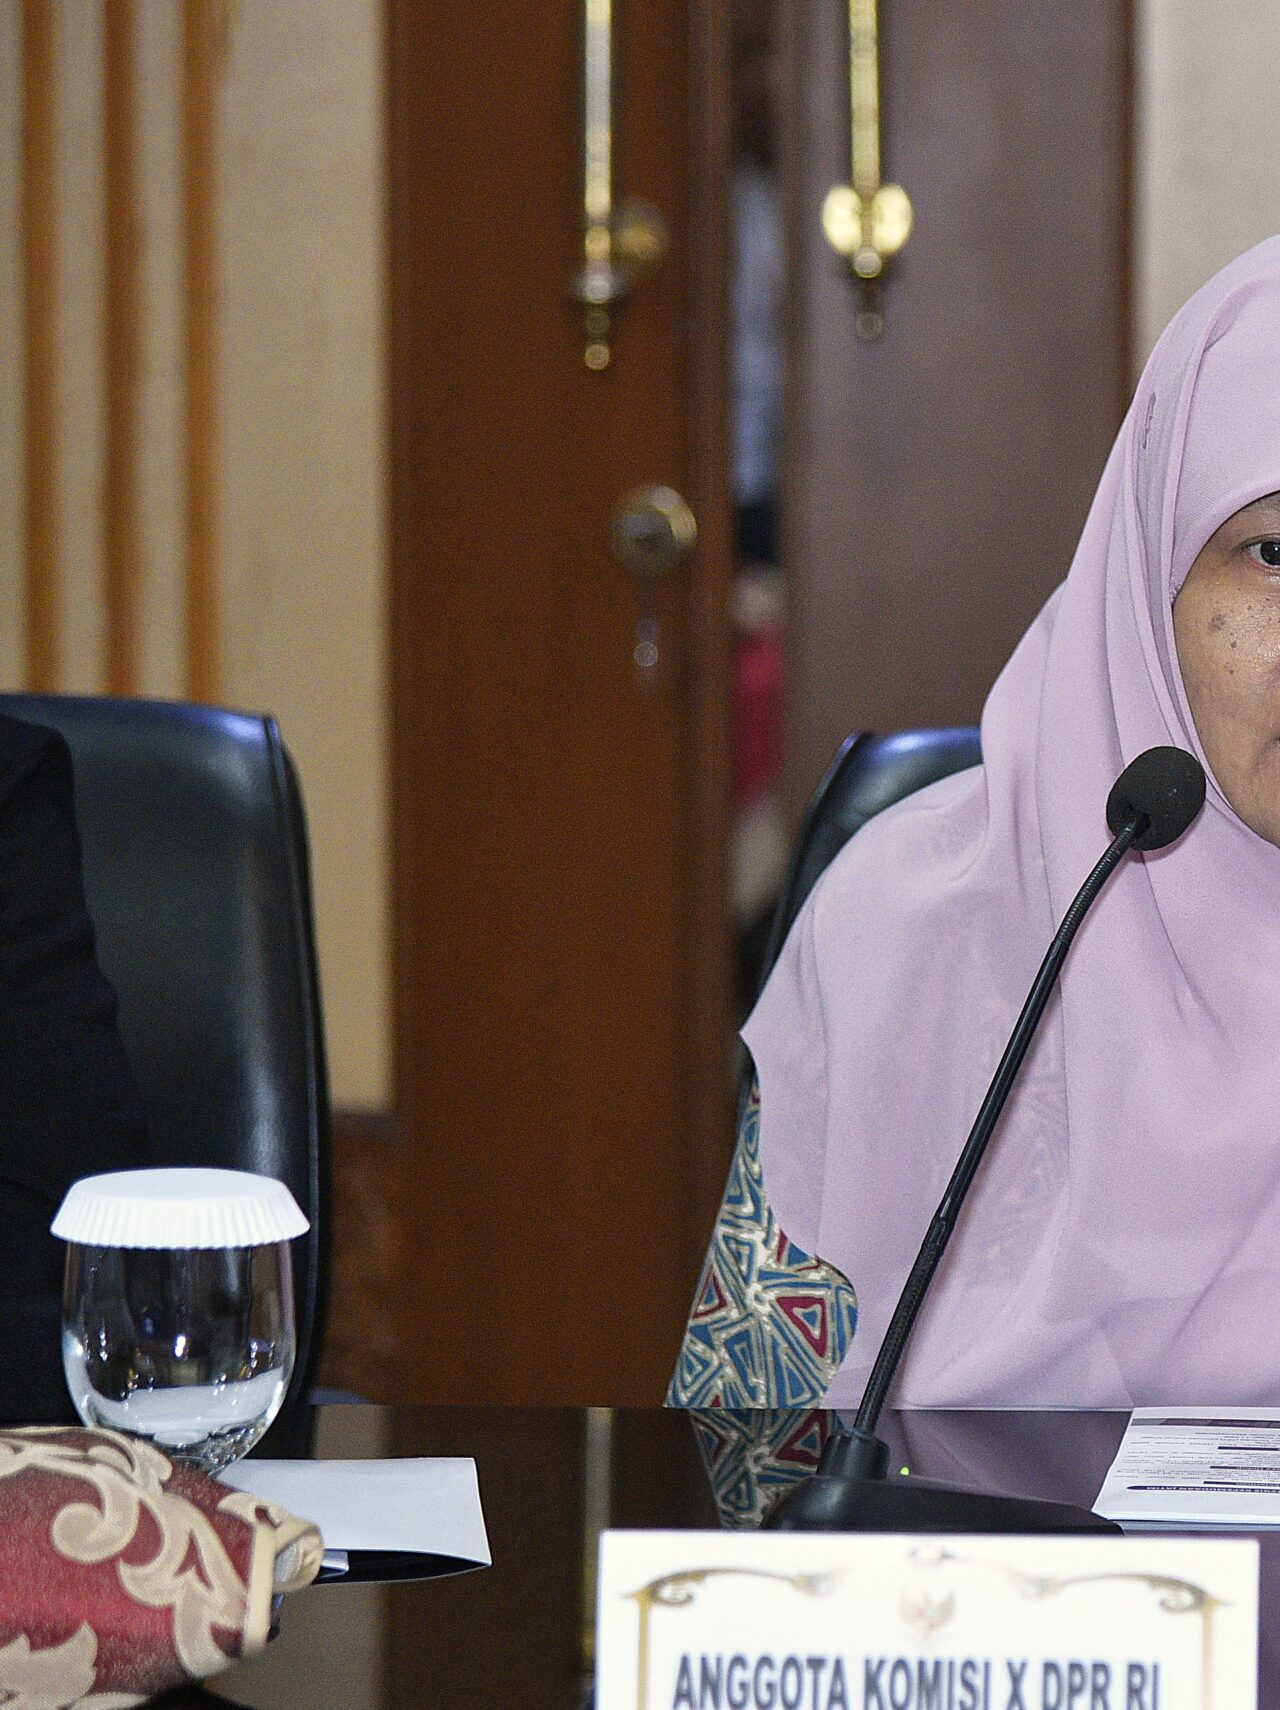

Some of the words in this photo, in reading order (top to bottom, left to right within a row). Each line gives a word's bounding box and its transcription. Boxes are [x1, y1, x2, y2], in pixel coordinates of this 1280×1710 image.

[672, 1654, 850, 1710] ANGGOTA
[864, 1657, 991, 1710] KOMISI
[1006, 1660, 1028, 1710] X
[1042, 1660, 1112, 1710] DPR
[1126, 1662, 1160, 1710] RI
